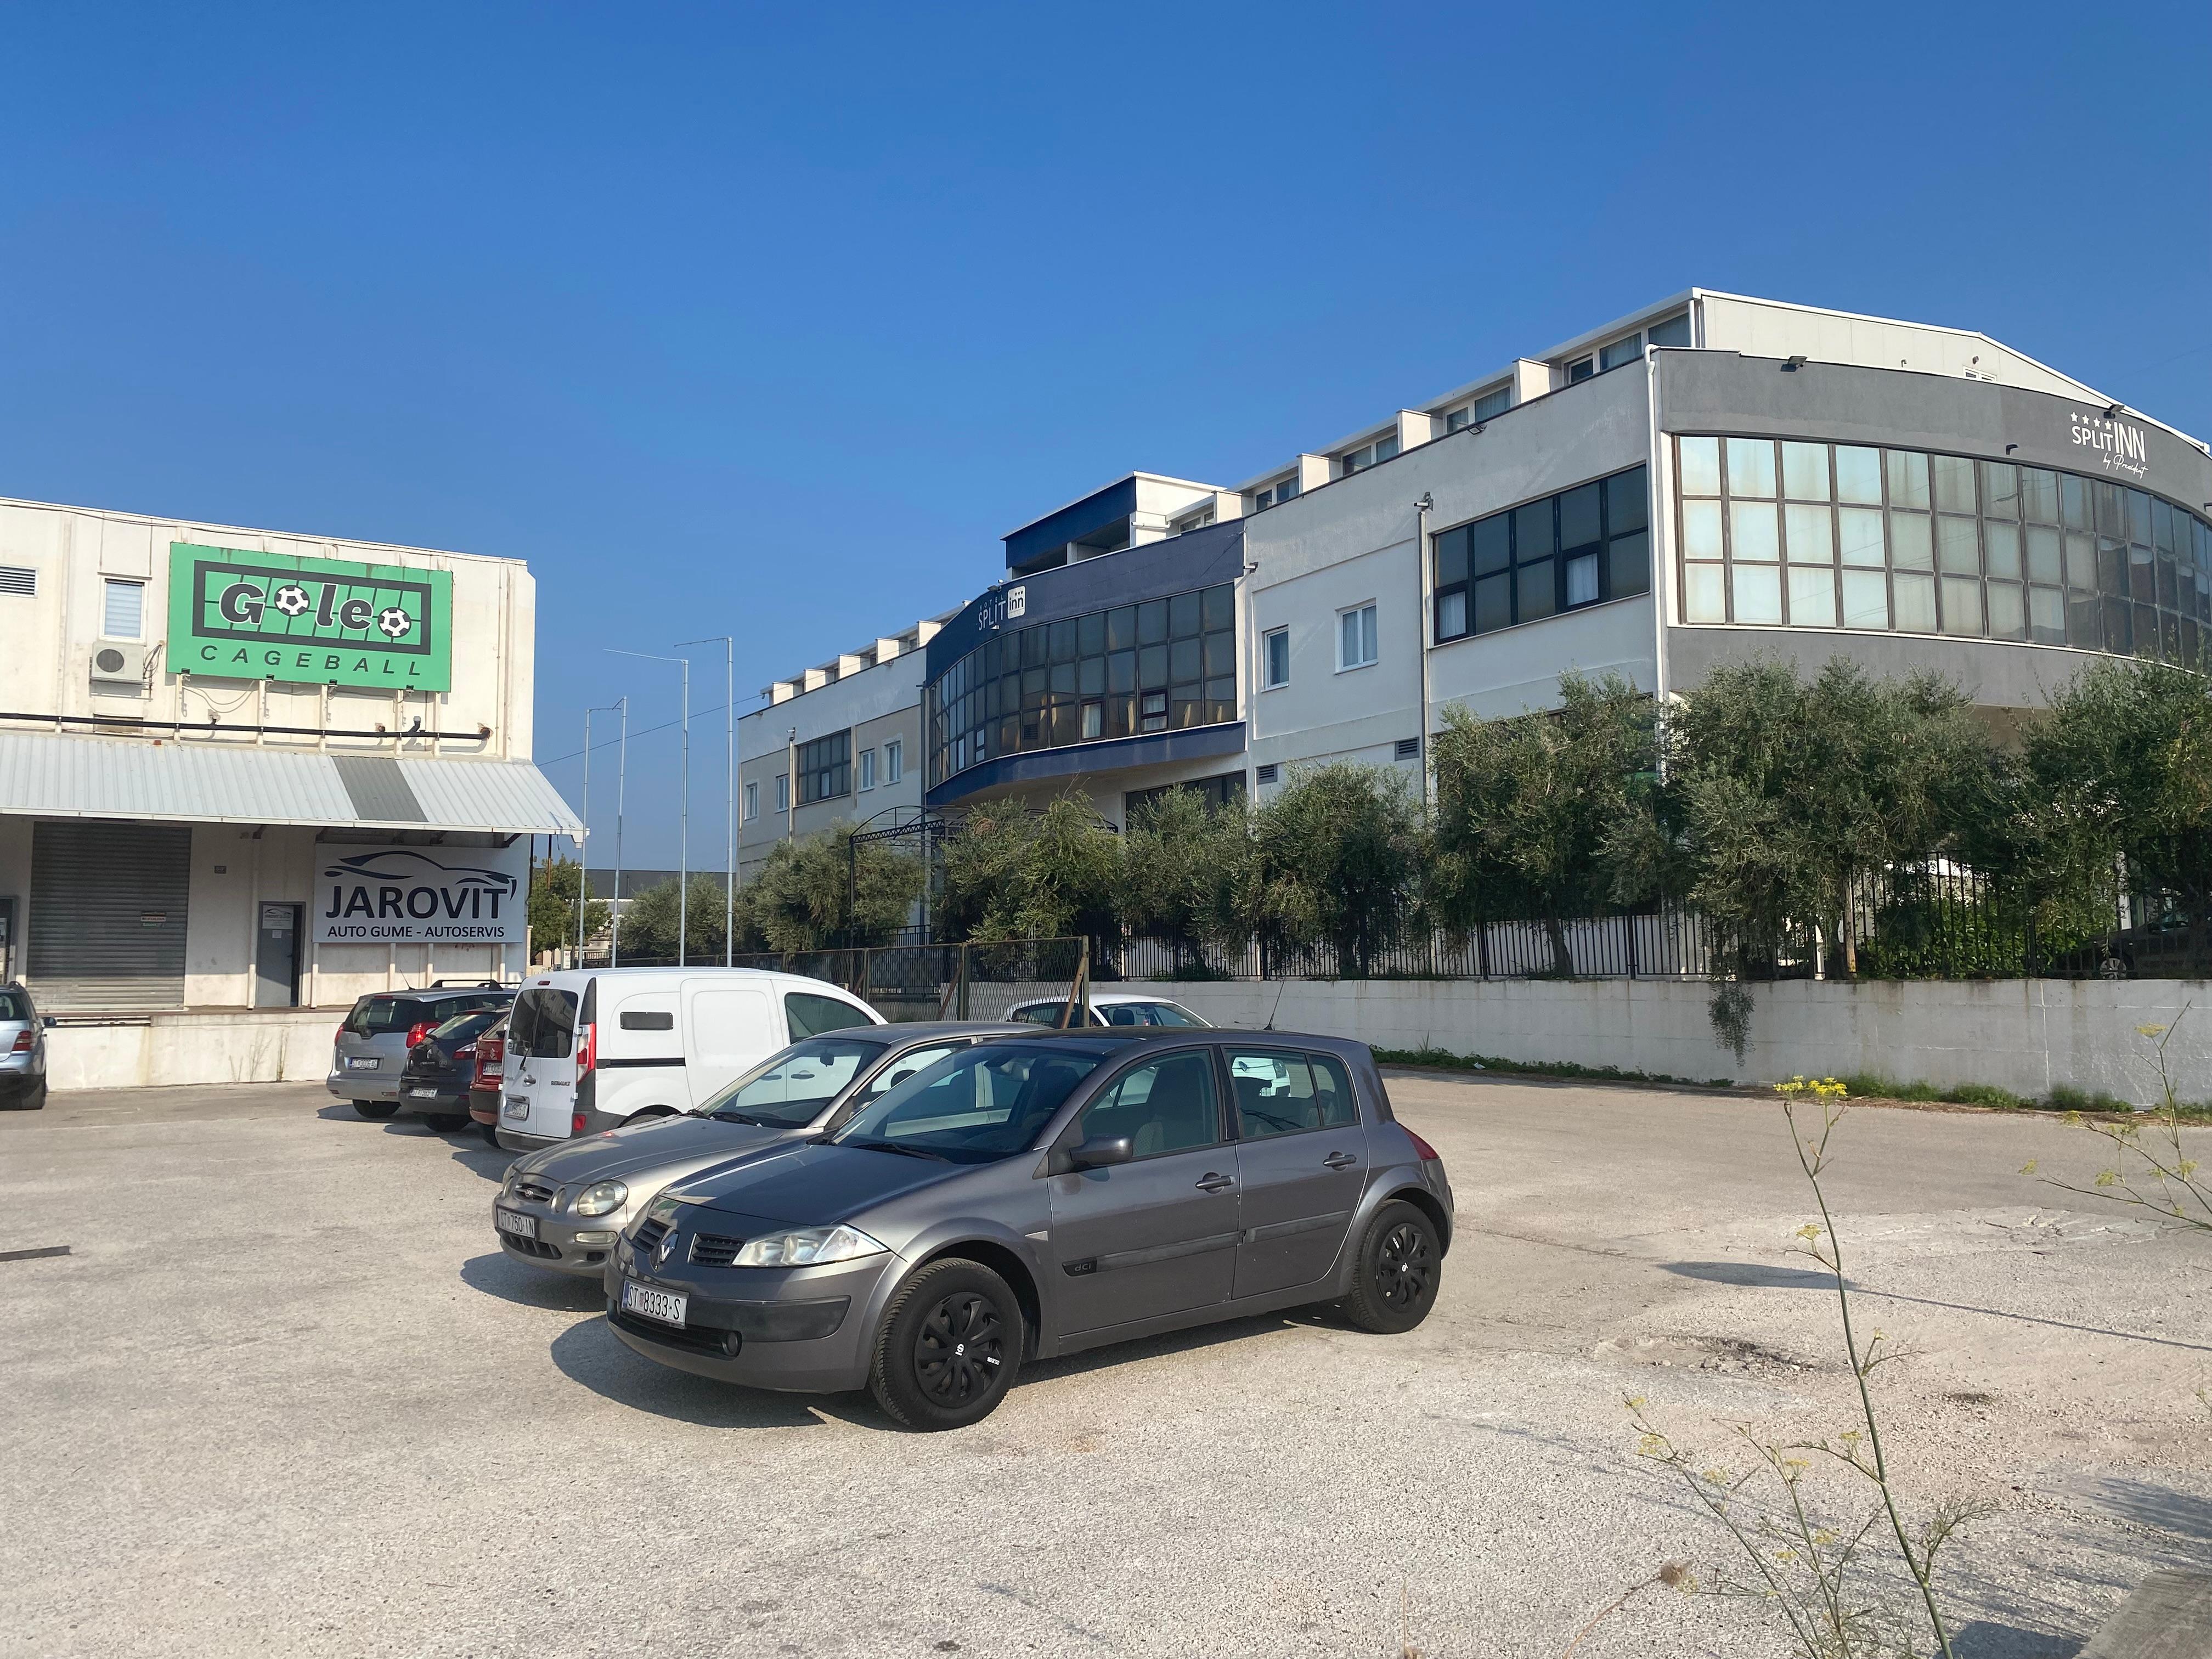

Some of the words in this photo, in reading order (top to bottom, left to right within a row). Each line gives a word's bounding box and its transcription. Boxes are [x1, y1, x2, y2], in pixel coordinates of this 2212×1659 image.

[2072, 425, 2113, 452] SPLIT
[2114, 421, 2146, 462] INN
[2103, 452, 2112, 470] by
[2113, 454, 2149, 479] President
[978, 600, 1006, 631] SPLIT
[1009, 597, 1024, 611] inn
[979, 594, 1004, 611] HOTEL
[200, 645, 421, 676] CAGEBALL
[325, 885, 508, 919] JAROVIT
[327, 926, 366, 938] AUTO
[370, 926, 413, 938] GUME
[425, 926, 505, 938] AUTOSERVIS
[628, 1285, 639, 1308] ST
[644, 1290, 681, 1320] 8333-S
